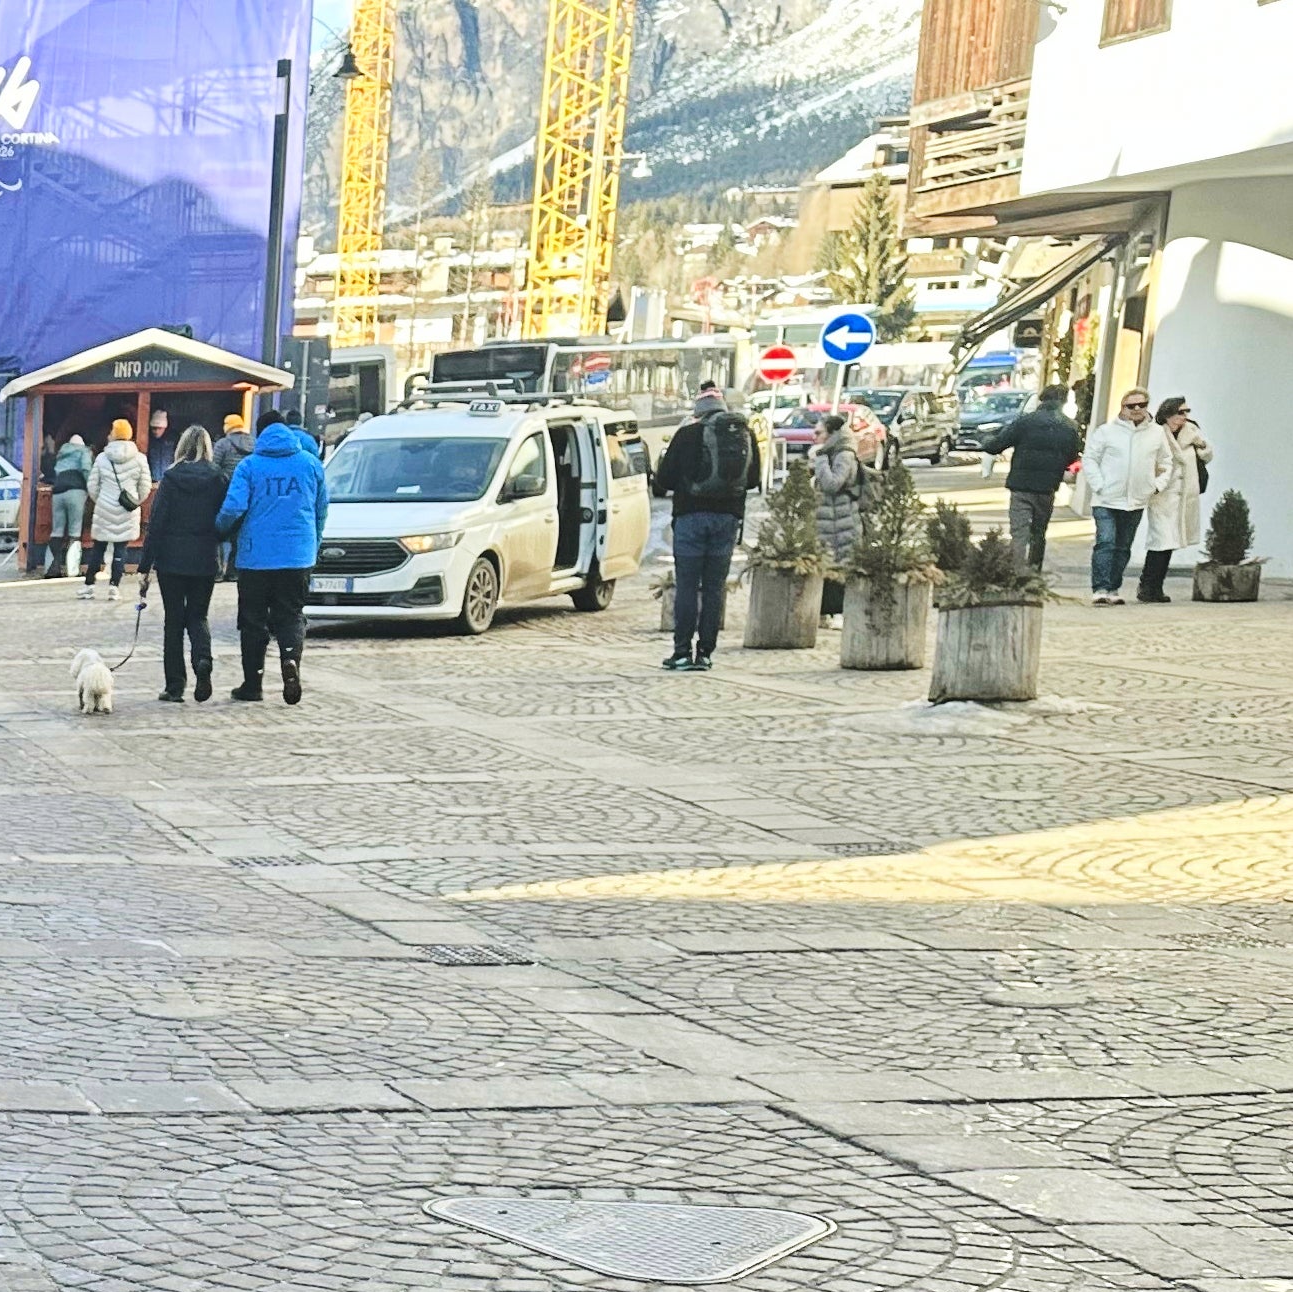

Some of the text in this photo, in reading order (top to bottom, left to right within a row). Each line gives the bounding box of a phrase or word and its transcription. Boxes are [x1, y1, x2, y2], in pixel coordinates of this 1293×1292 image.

[1, 132, 60, 145] CORTINA
[114, 361, 180, 378] INFO POINT
[470, 403, 500, 412] TAXI
[266, 477, 302, 496] ITA
